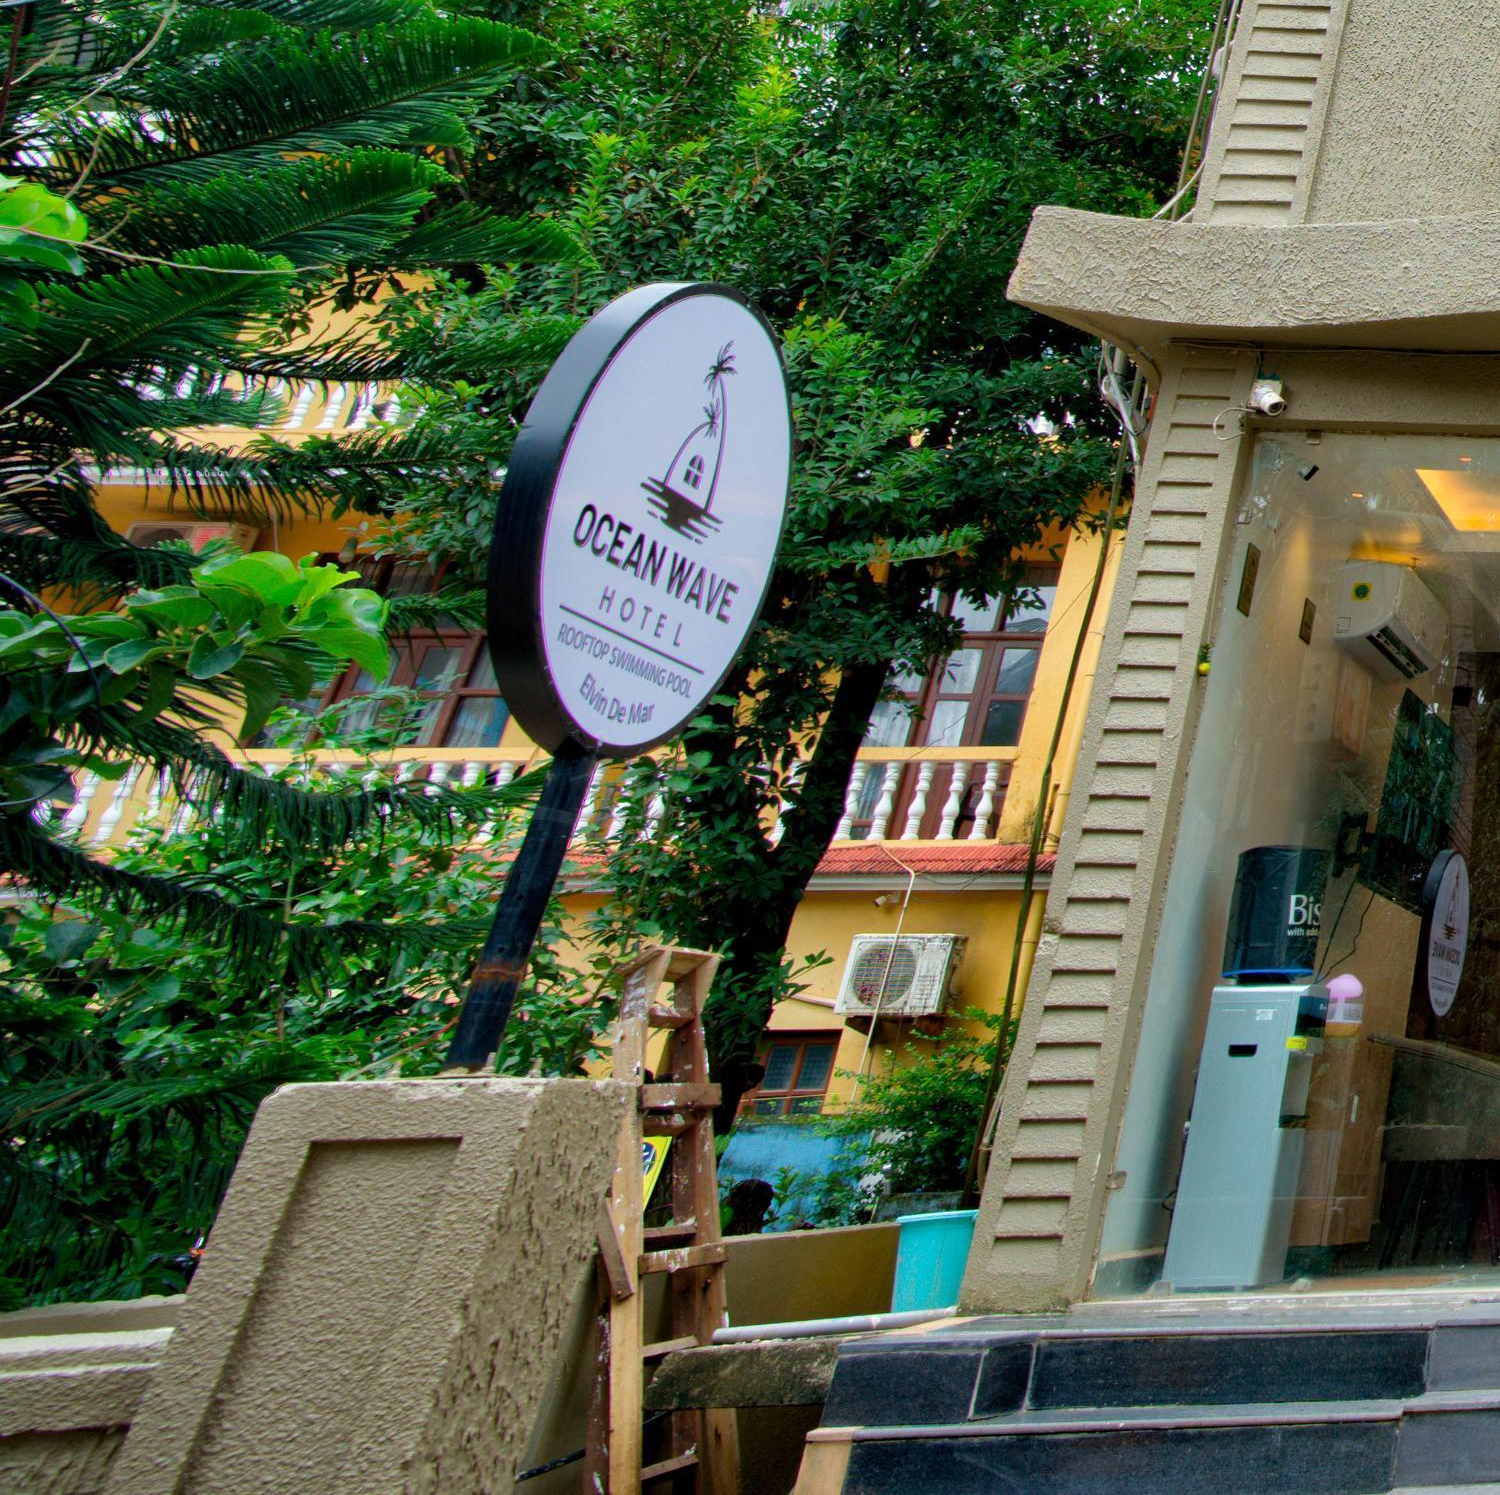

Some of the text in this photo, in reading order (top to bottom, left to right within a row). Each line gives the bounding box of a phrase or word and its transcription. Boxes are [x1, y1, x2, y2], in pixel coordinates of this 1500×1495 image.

[573, 503, 740, 625] OCEAN WAVE
[598, 585, 683, 647] HOTEL
[557, 622, 693, 699] ROOFTOP SWIMMING POOL
[579, 671, 656, 725] Elvin De Mar
